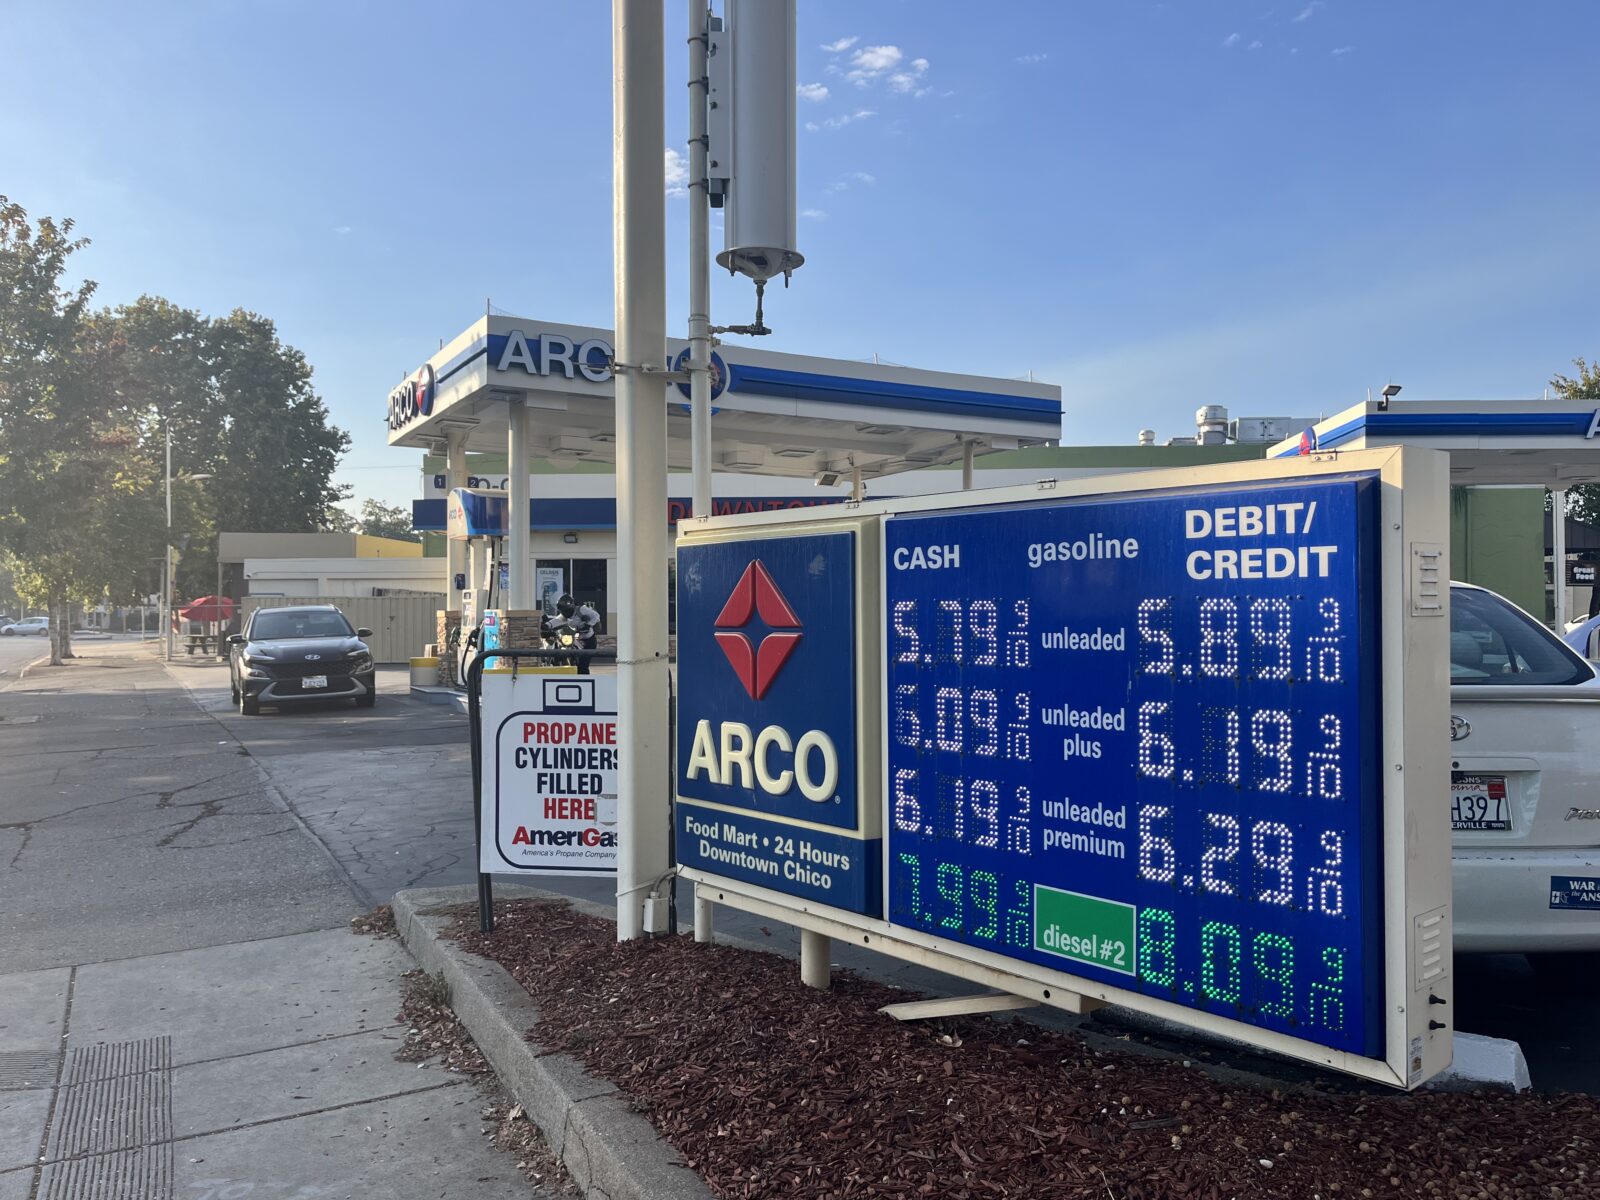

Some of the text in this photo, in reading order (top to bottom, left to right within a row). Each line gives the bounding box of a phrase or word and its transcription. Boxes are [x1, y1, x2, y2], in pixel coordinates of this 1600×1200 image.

[496, 329, 617, 383] ARC
[389, 380, 415, 428] ARCO
[1185, 501, 1317, 539] DEBIT/
[893, 533, 1139, 571] CASH gasoline
[1186, 545, 1338, 580] CREDIT
[894, 600, 998, 666] 5.79
[1041, 626, 1126, 651] unleaded
[1138, 598, 1291, 680] 5.89
[523, 722, 617, 745] PROPANE
[895, 684, 998, 756] 6.09
[1041, 703, 1126, 732] unleaded
[686, 719, 838, 802] ARCO
[1063, 733, 1103, 760] plus
[1138, 701, 1292, 793] 6.19
[537, 773, 603, 795] FILLED
[543, 798, 596, 820] HERE
[895, 768, 999, 848] 6.19
[1042, 797, 1126, 829] unleaded
[521, 849, 617, 860] America's Propane Company
[685, 816, 850, 871] Food Mart 24 Hours
[699, 840, 832, 889] Downtown Chico
[1043, 829, 1126, 859] premium
[1139, 804, 1293, 906] 6.29
[899, 852, 998, 940] 7.99
[1569, 881, 1595, 890] WAR
[1043, 923, 1126, 967] diesel #2
[1139, 907, 1294, 1017] 8.09
